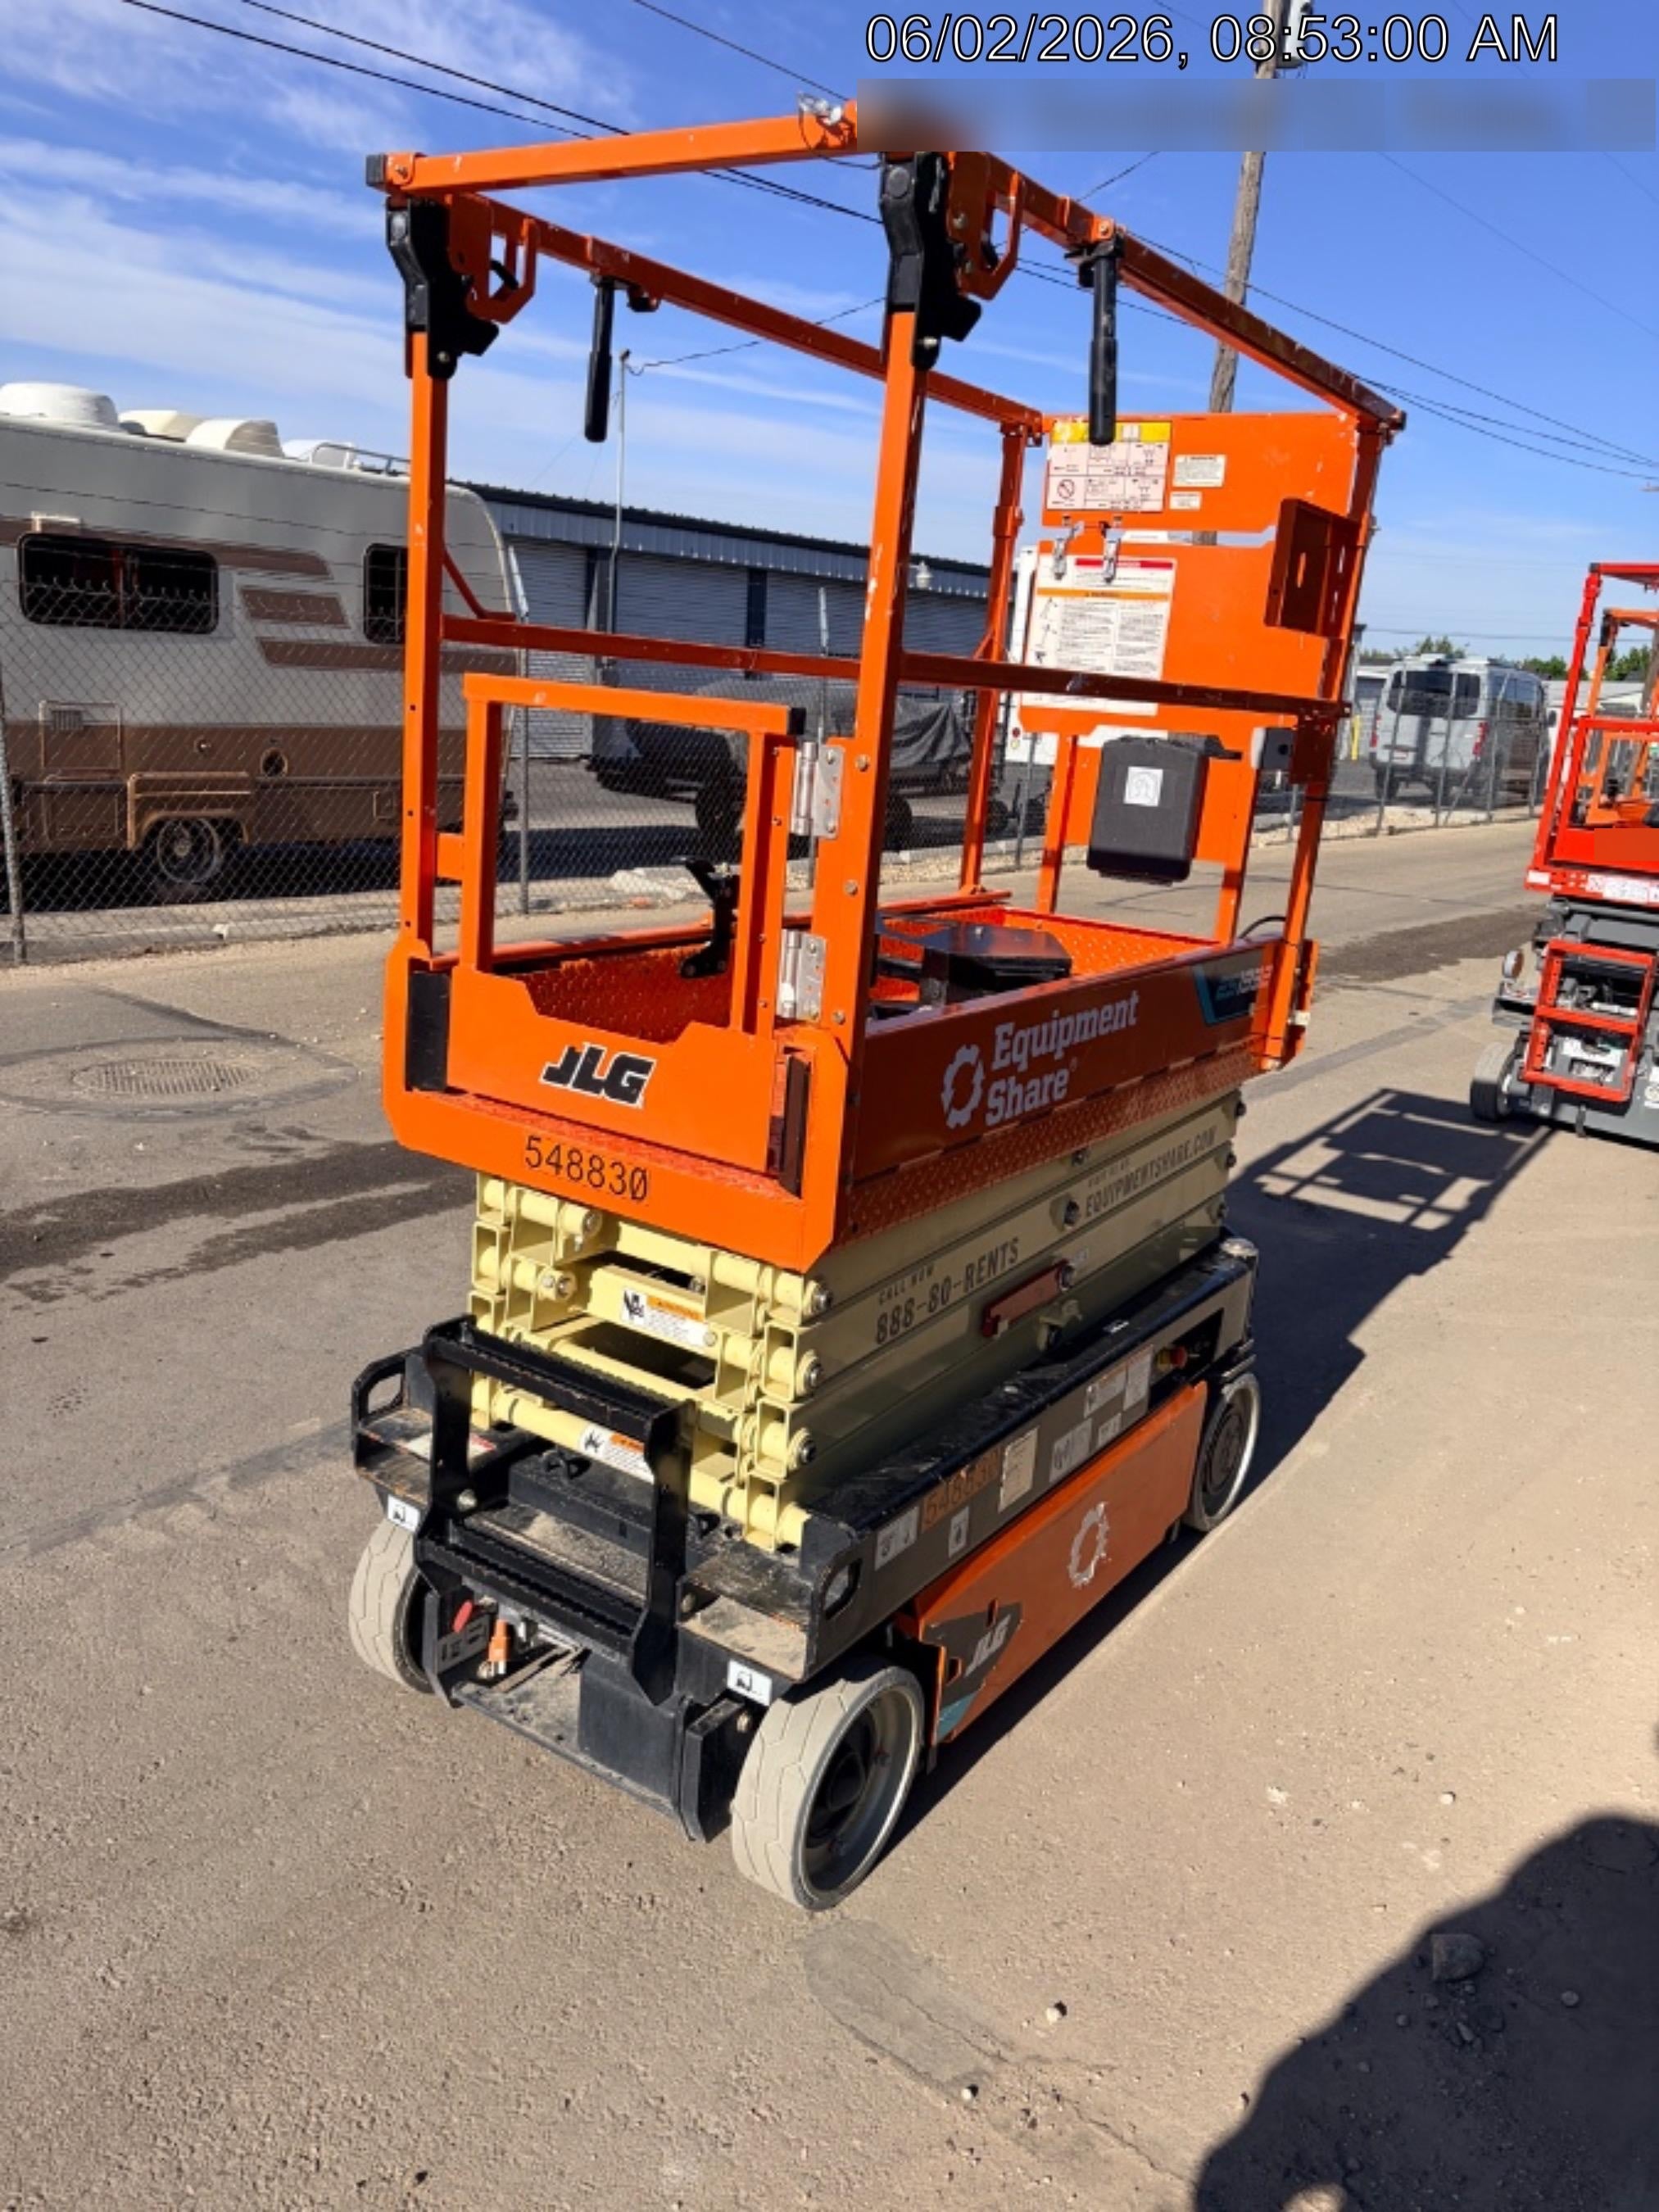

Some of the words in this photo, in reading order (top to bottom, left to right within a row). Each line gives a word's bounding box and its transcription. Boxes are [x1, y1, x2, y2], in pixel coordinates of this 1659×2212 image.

[992, 990, 1139, 1071] Equipment
[539, 1041, 657, 1109] JLG
[525, 1135, 648, 1201] 548830
[876, 1237, 1019, 1344] 888-80-RENTS
[964, 1614, 1012, 1677] JLG
